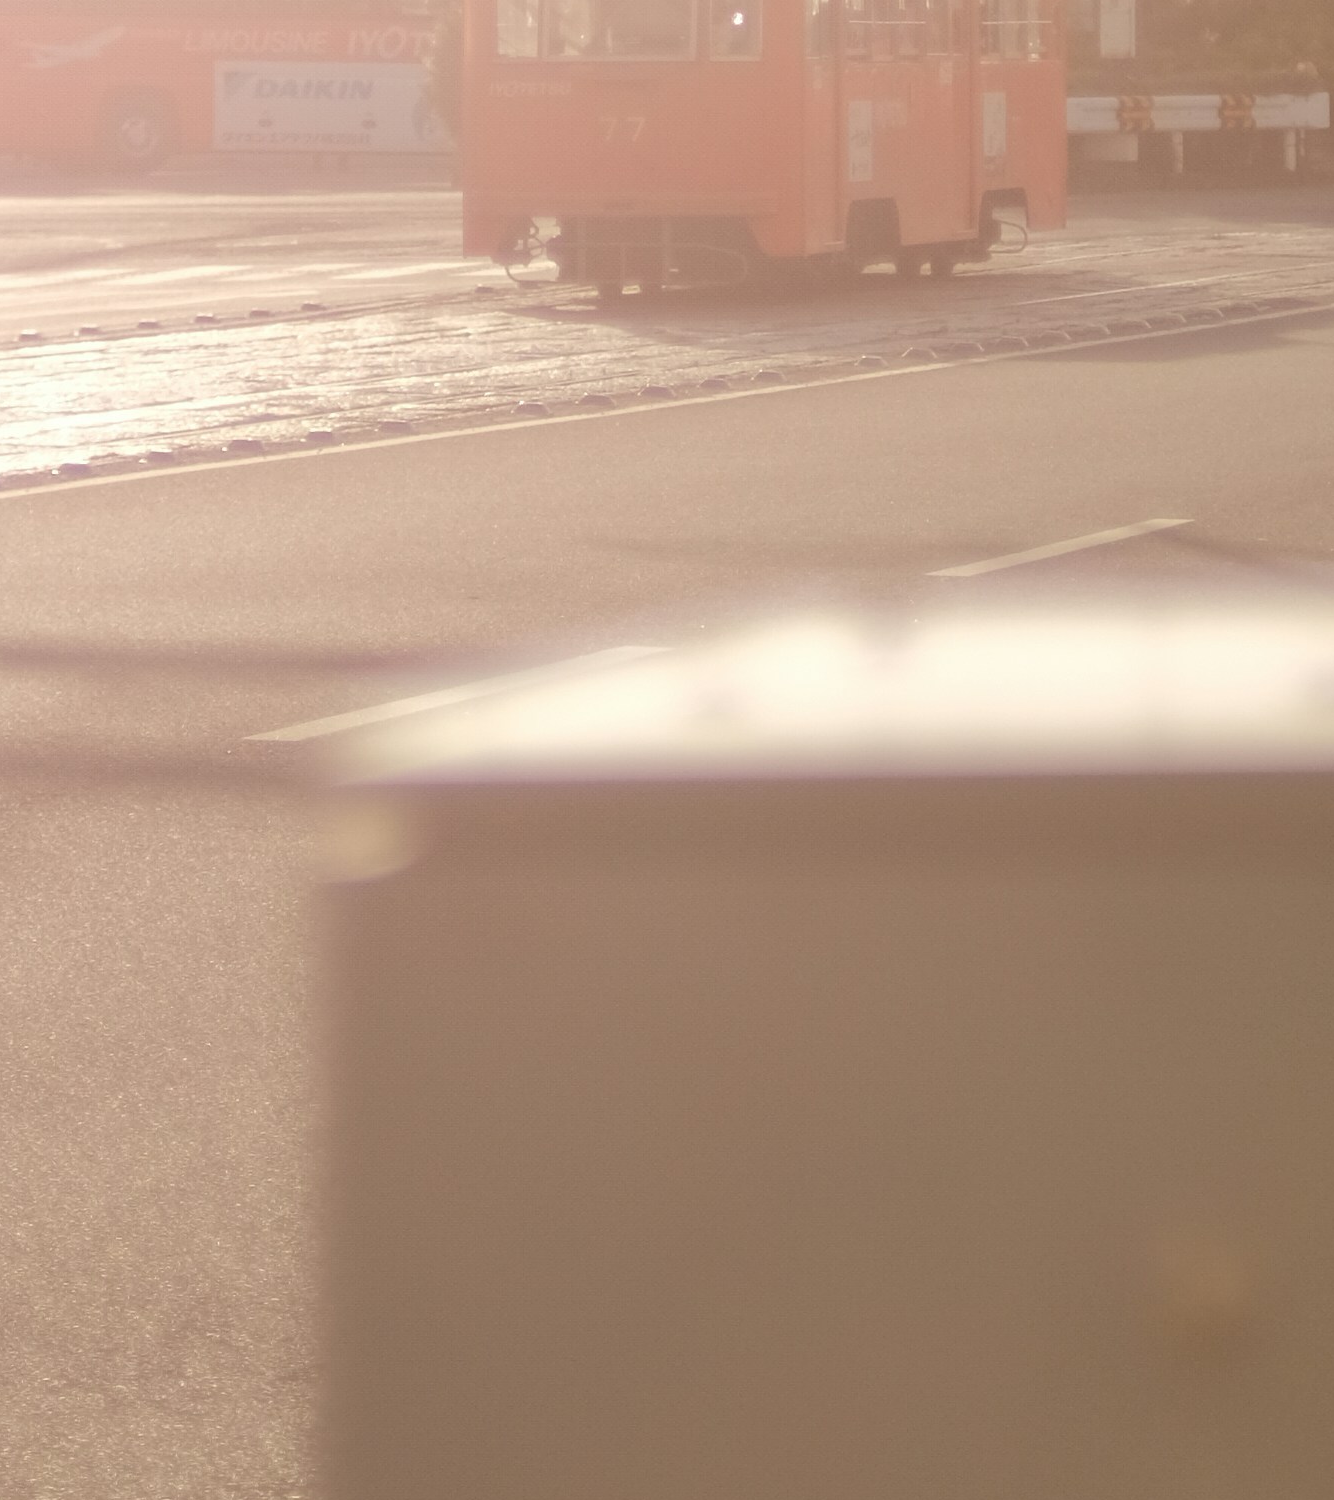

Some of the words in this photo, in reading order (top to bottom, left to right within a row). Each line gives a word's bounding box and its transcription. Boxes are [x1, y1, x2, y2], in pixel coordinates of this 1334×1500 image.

[182, 28, 329, 53] LIMOUSINE
[253, 78, 375, 100] DAIKIN
[488, 80, 573, 98] IYOTETSU
[598, 115, 647, 143] 77
